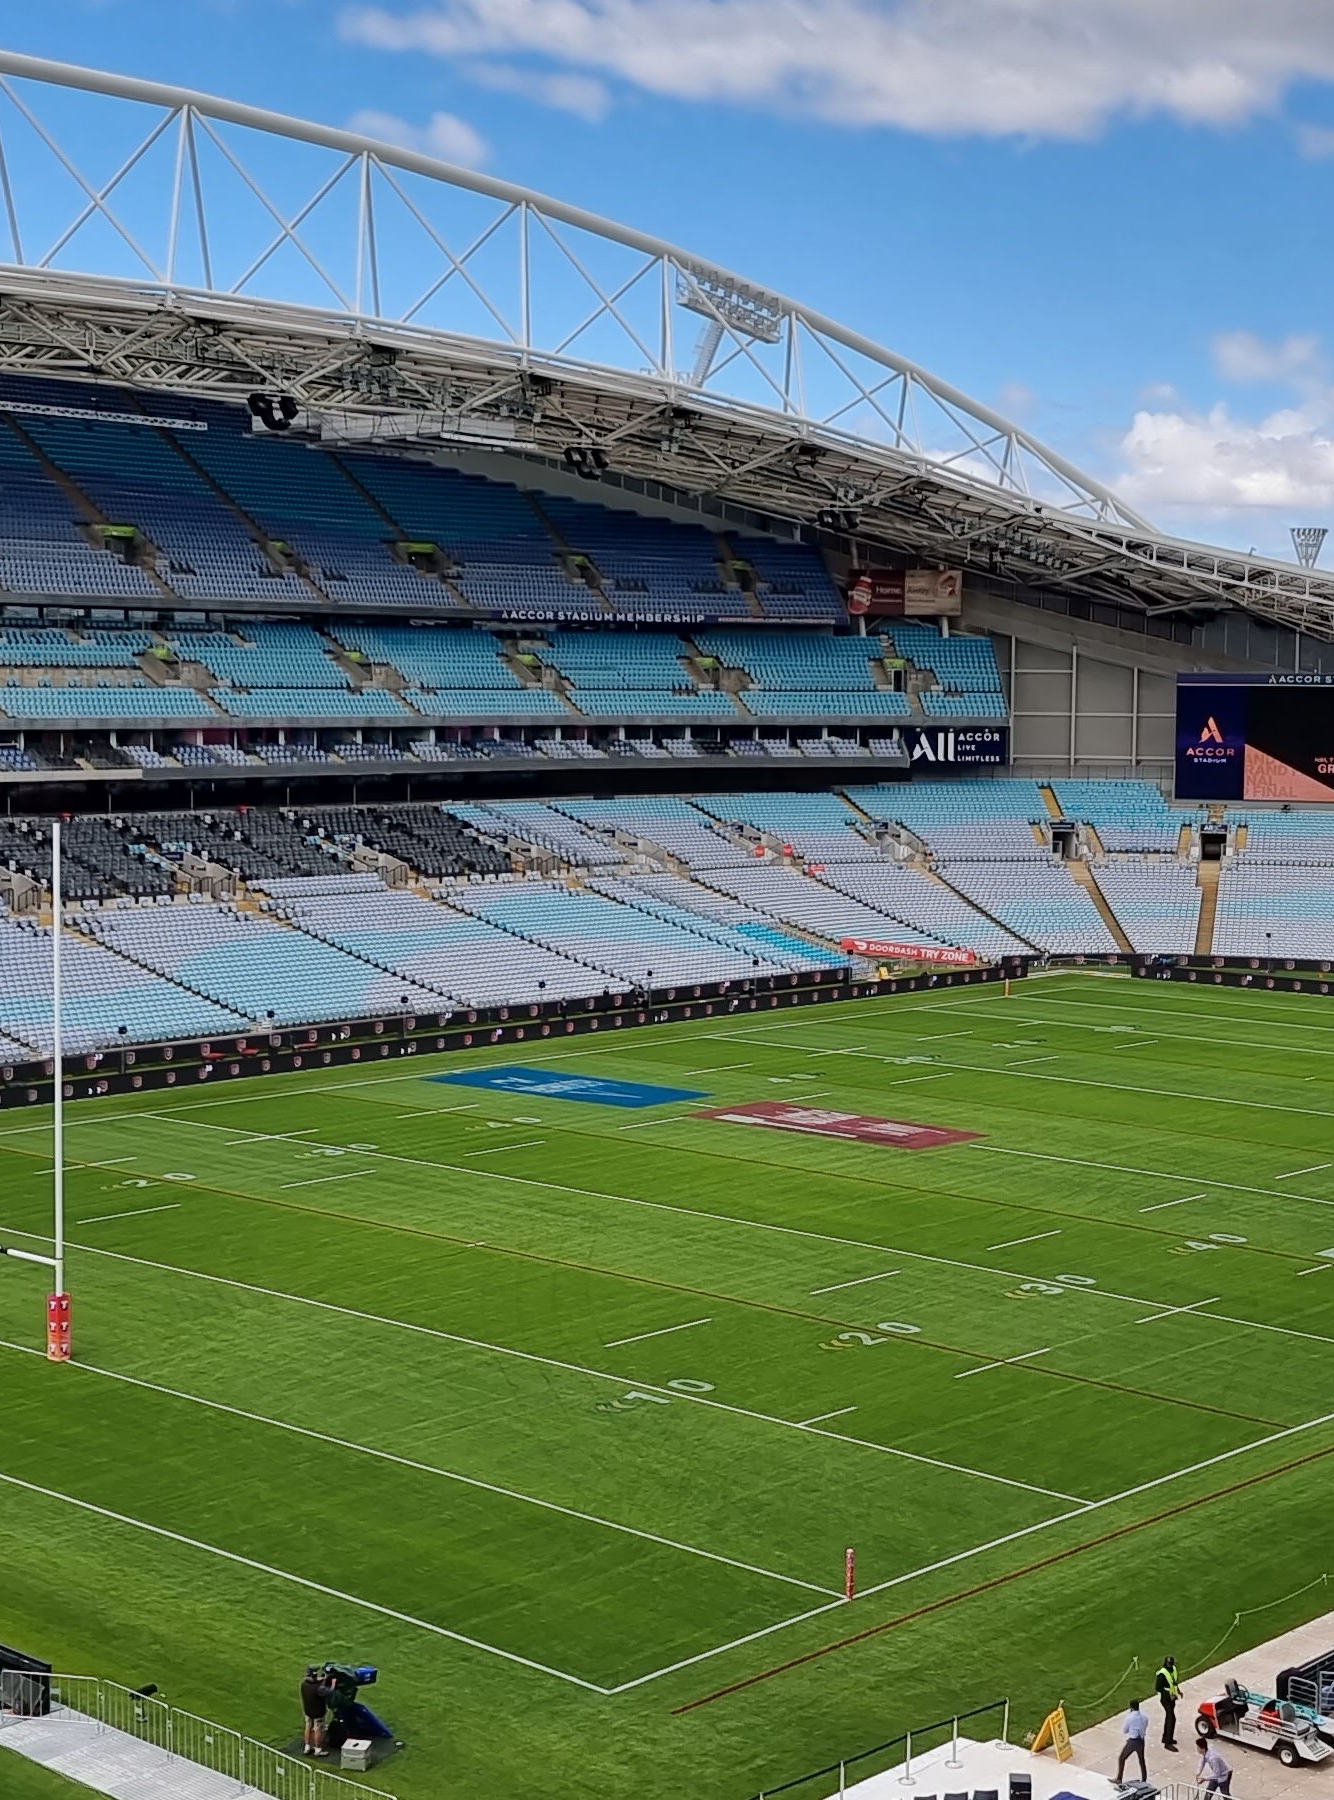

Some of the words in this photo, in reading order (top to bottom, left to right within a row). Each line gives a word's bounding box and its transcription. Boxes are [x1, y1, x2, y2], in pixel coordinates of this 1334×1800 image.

[510, 611, 554, 620] ACCOR
[557, 611, 613, 621] STADIUM
[616, 612, 705, 623] MEMBERSHIP
[1278, 675, 1321, 684] ACCOR
[957, 732, 1001, 742] ACCOR
[910, 732, 955, 761] All
[1186, 747, 1235, 757] ACCOR
[869, 943, 918, 956] DOORDASH
[919, 948, 940, 960] TRY
[941, 951, 969, 962] ZONE
